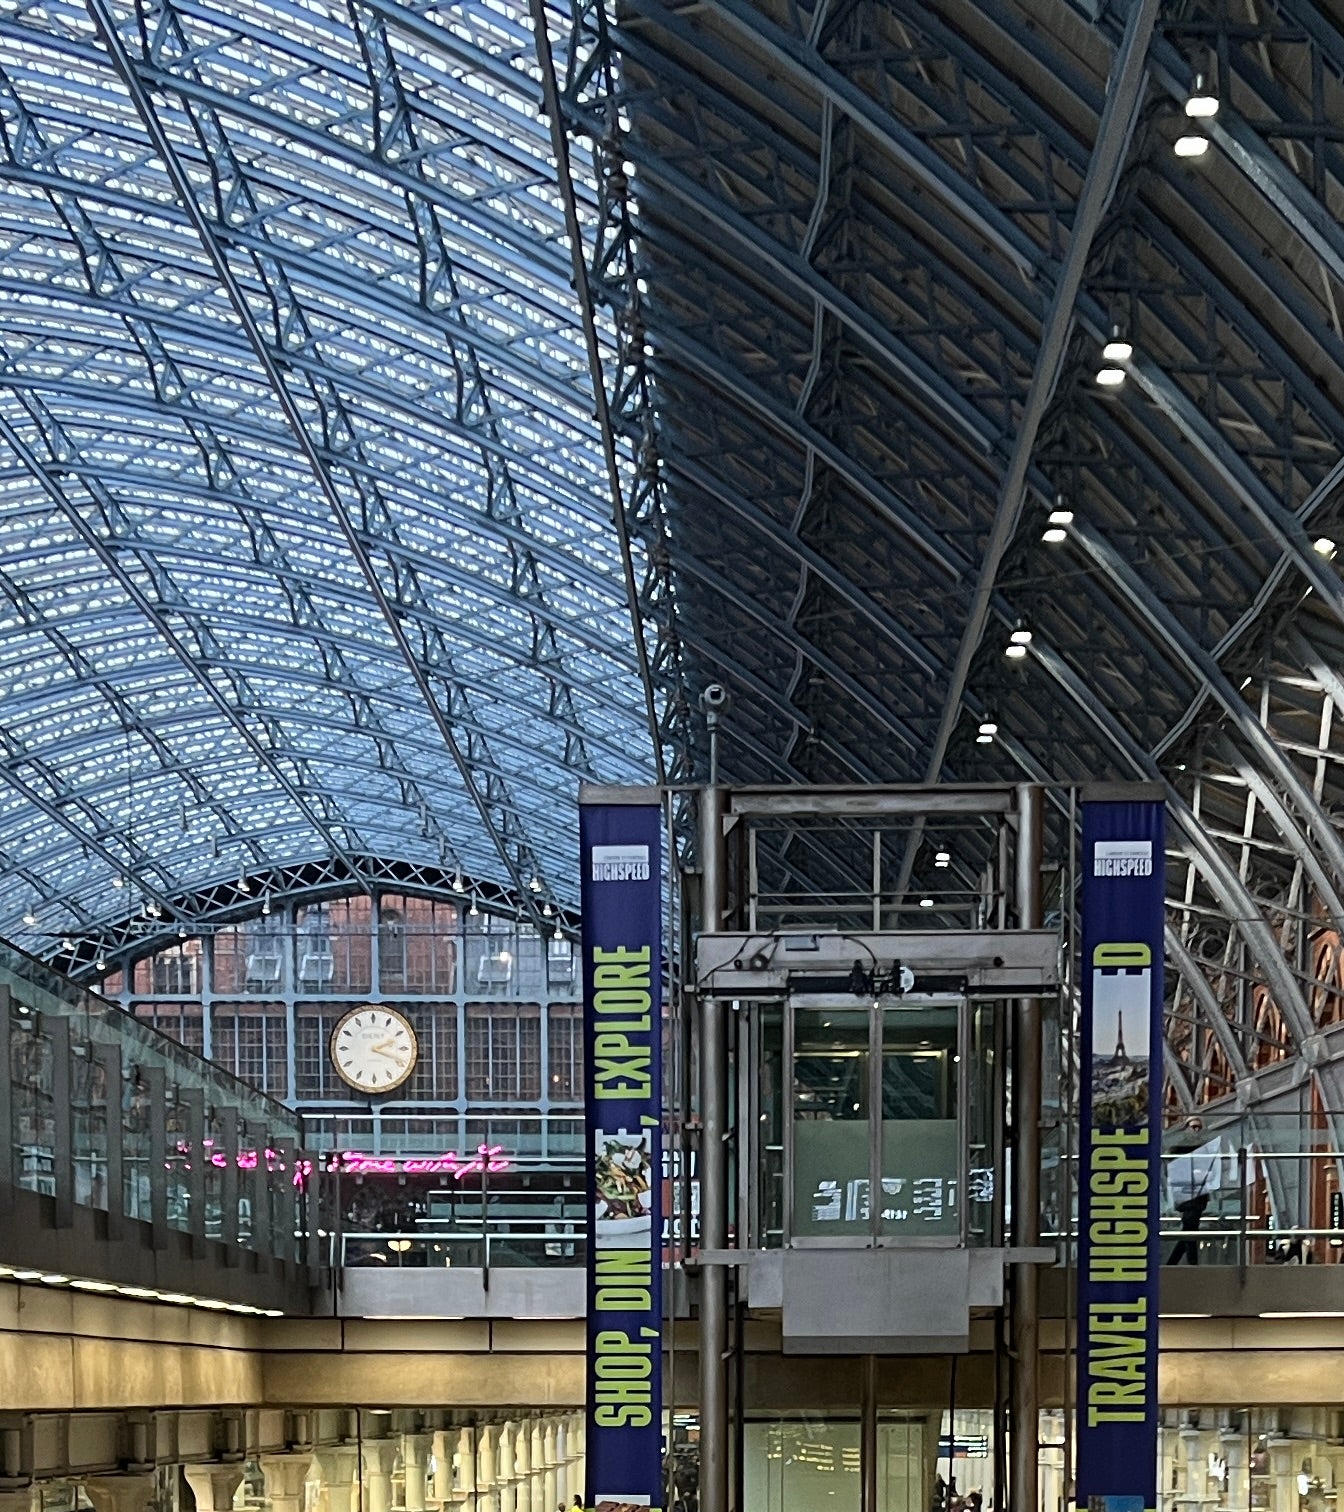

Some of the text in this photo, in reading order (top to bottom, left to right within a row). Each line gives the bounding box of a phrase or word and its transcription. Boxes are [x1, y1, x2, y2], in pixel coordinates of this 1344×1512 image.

[592, 863, 650, 881] HIGHSPEED
[1094, 858, 1152, 877] HIGHSPEED
[593, 945, 651, 1100] EXPLORE
[594, 1327, 660, 1428] SHOP,
[1087, 1297, 1147, 1428] TRAVEL
